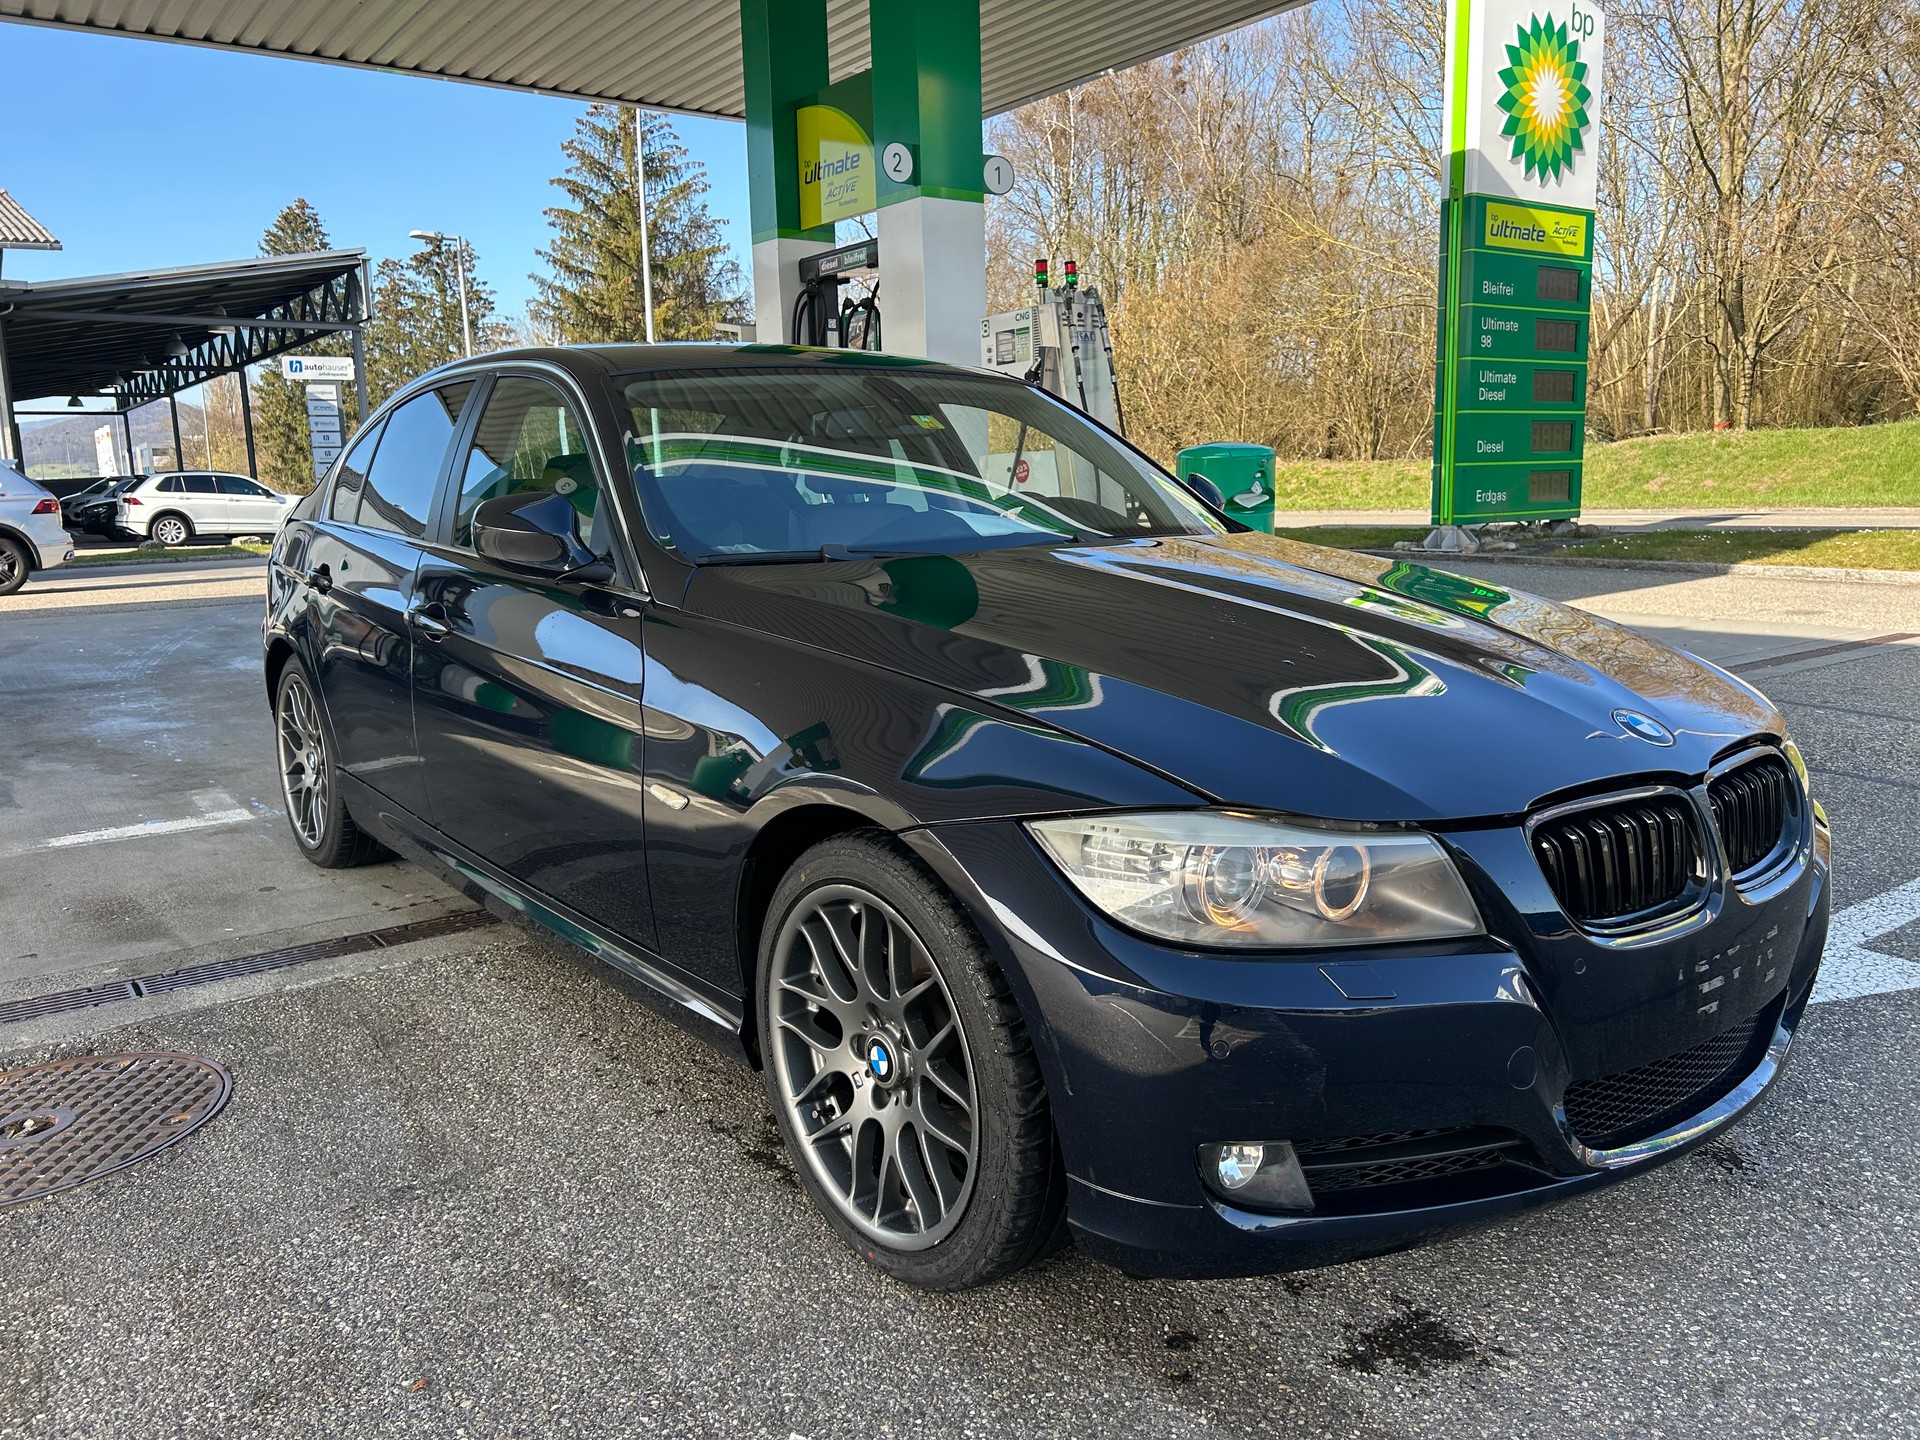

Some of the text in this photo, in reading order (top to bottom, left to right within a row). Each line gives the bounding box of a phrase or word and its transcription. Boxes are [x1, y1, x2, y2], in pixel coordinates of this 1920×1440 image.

[1571, 2, 1594, 42] bp
[804, 150, 860, 185] ultimate
[893, 152, 902, 173] 2
[994, 166, 1001, 185] 1
[1490, 212, 1499, 223] bp
[1489, 219, 1546, 243] ultimate
[1552, 226, 1579, 238] ACTIVE
[821, 258, 838, 271] diesel
[1482, 280, 1514, 296] Bleifrei
[1015, 311, 1030, 322] CNG
[1481, 316, 1519, 332] Ultimate
[1480, 335, 1492, 348] 98
[1479, 369, 1517, 385] Ultimate
[1478, 387, 1506, 401] Diesel
[1476, 440, 1504, 453] Diesel
[1475, 489, 1507, 504] Erdgas
